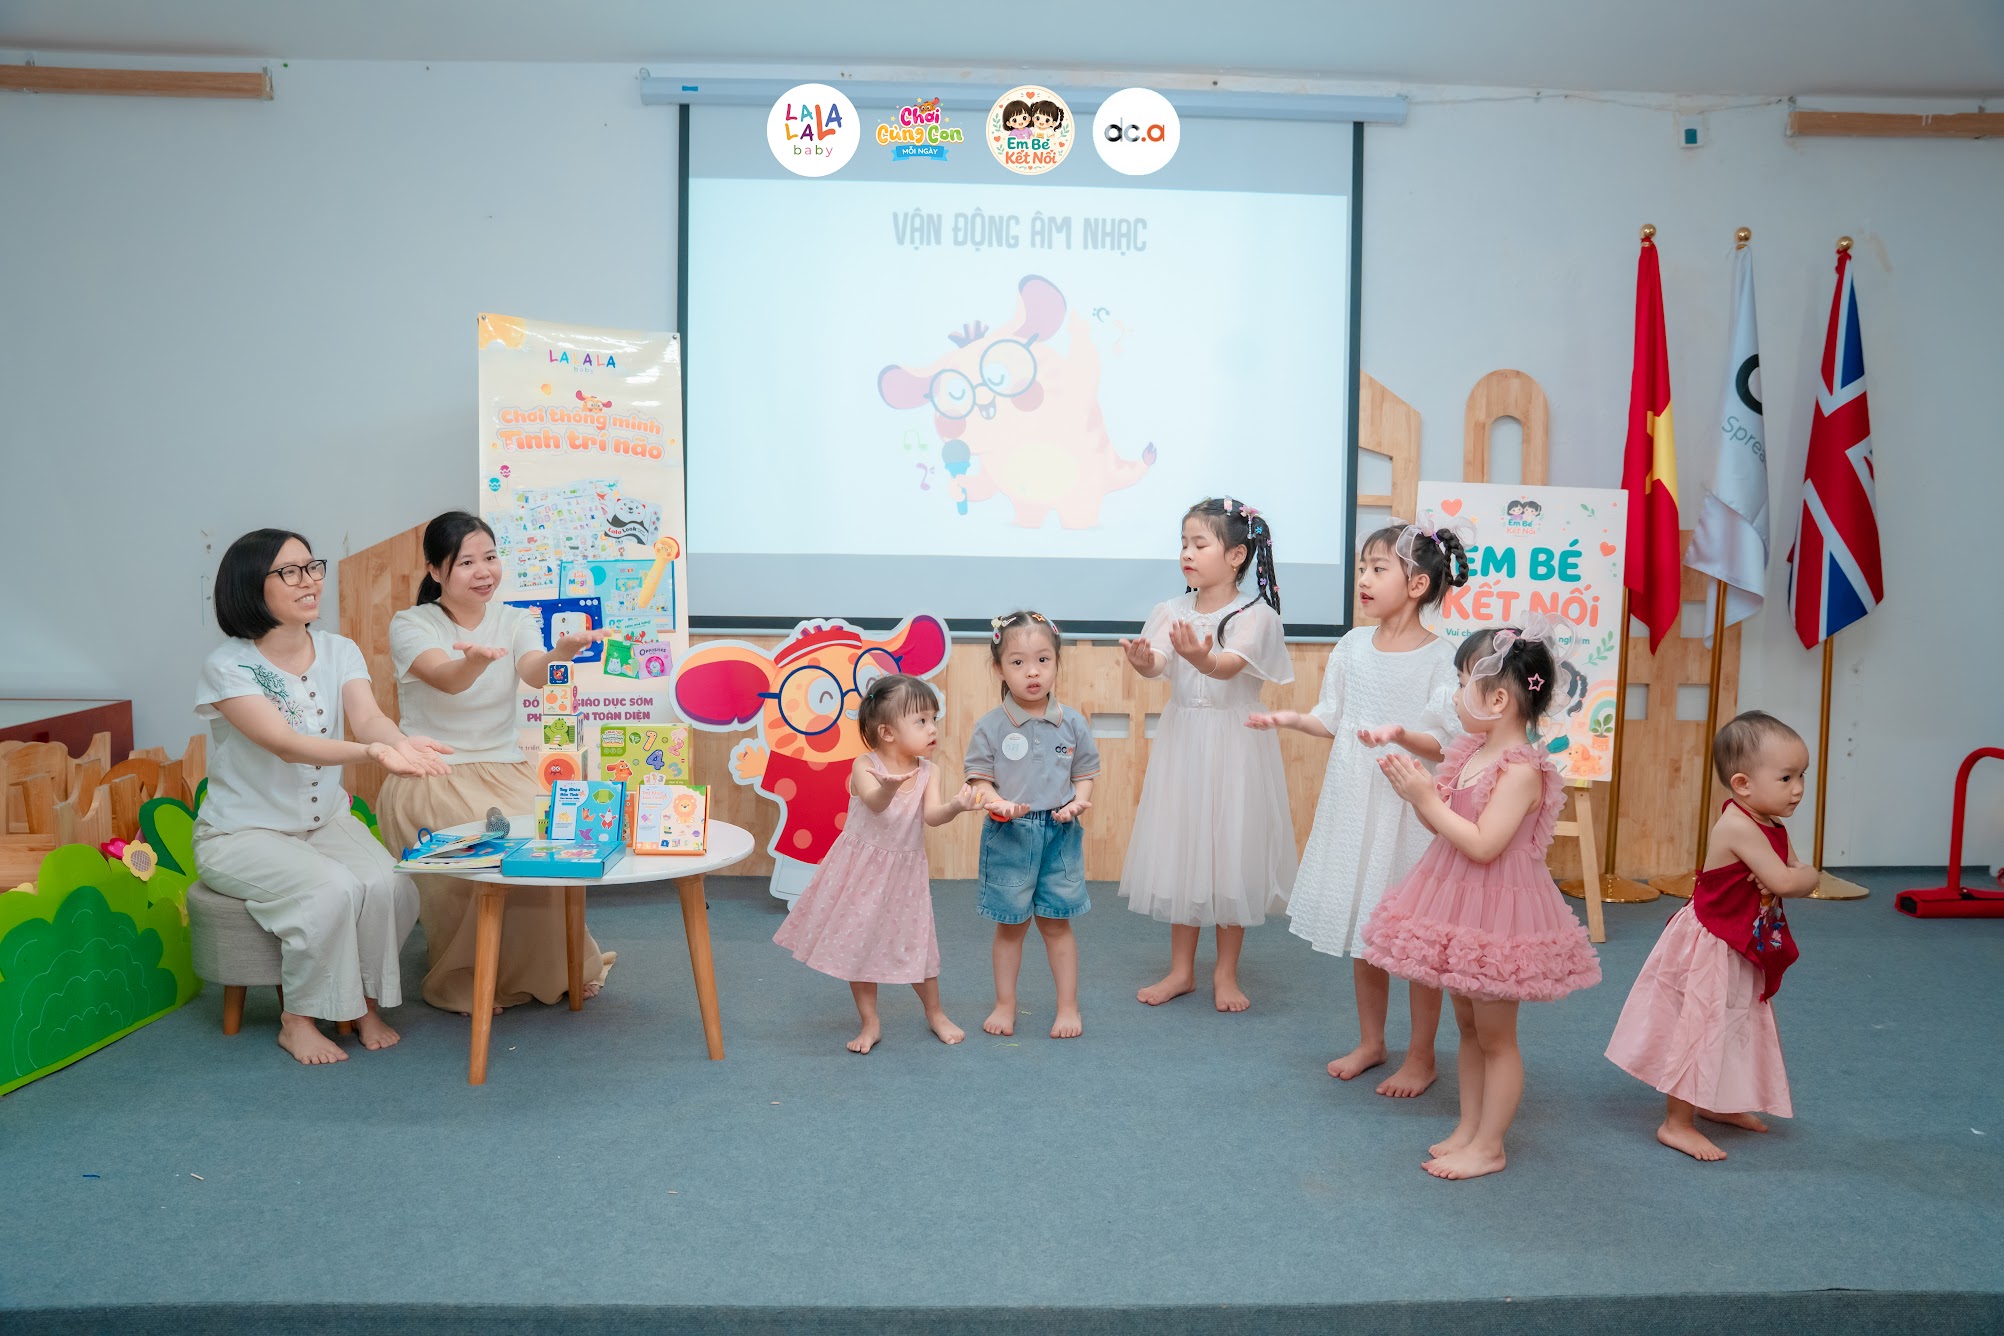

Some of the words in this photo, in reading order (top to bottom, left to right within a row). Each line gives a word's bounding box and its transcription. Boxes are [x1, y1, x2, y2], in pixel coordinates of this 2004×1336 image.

[892, 206, 943, 251] VẬN
[952, 206, 1020, 252] ĐỘNG
[1030, 210, 1072, 250] ÂM
[1083, 217, 1148, 257] NHẠC
[549, 408, 607, 431] thông
[612, 415, 662, 435] minh
[566, 430, 607, 452] trí
[613, 437, 663, 460] não
[1529, 538, 1583, 583] BÉ
[1442, 578, 1521, 622] KẾT
[1445, 628, 1459, 637] Vui
[603, 698, 627, 709] DỤC
[591, 710, 621, 721] TOÀN
[624, 710, 650, 723] DIỆN
[643, 730, 657, 751] 1
[645, 749, 665, 770] 4
